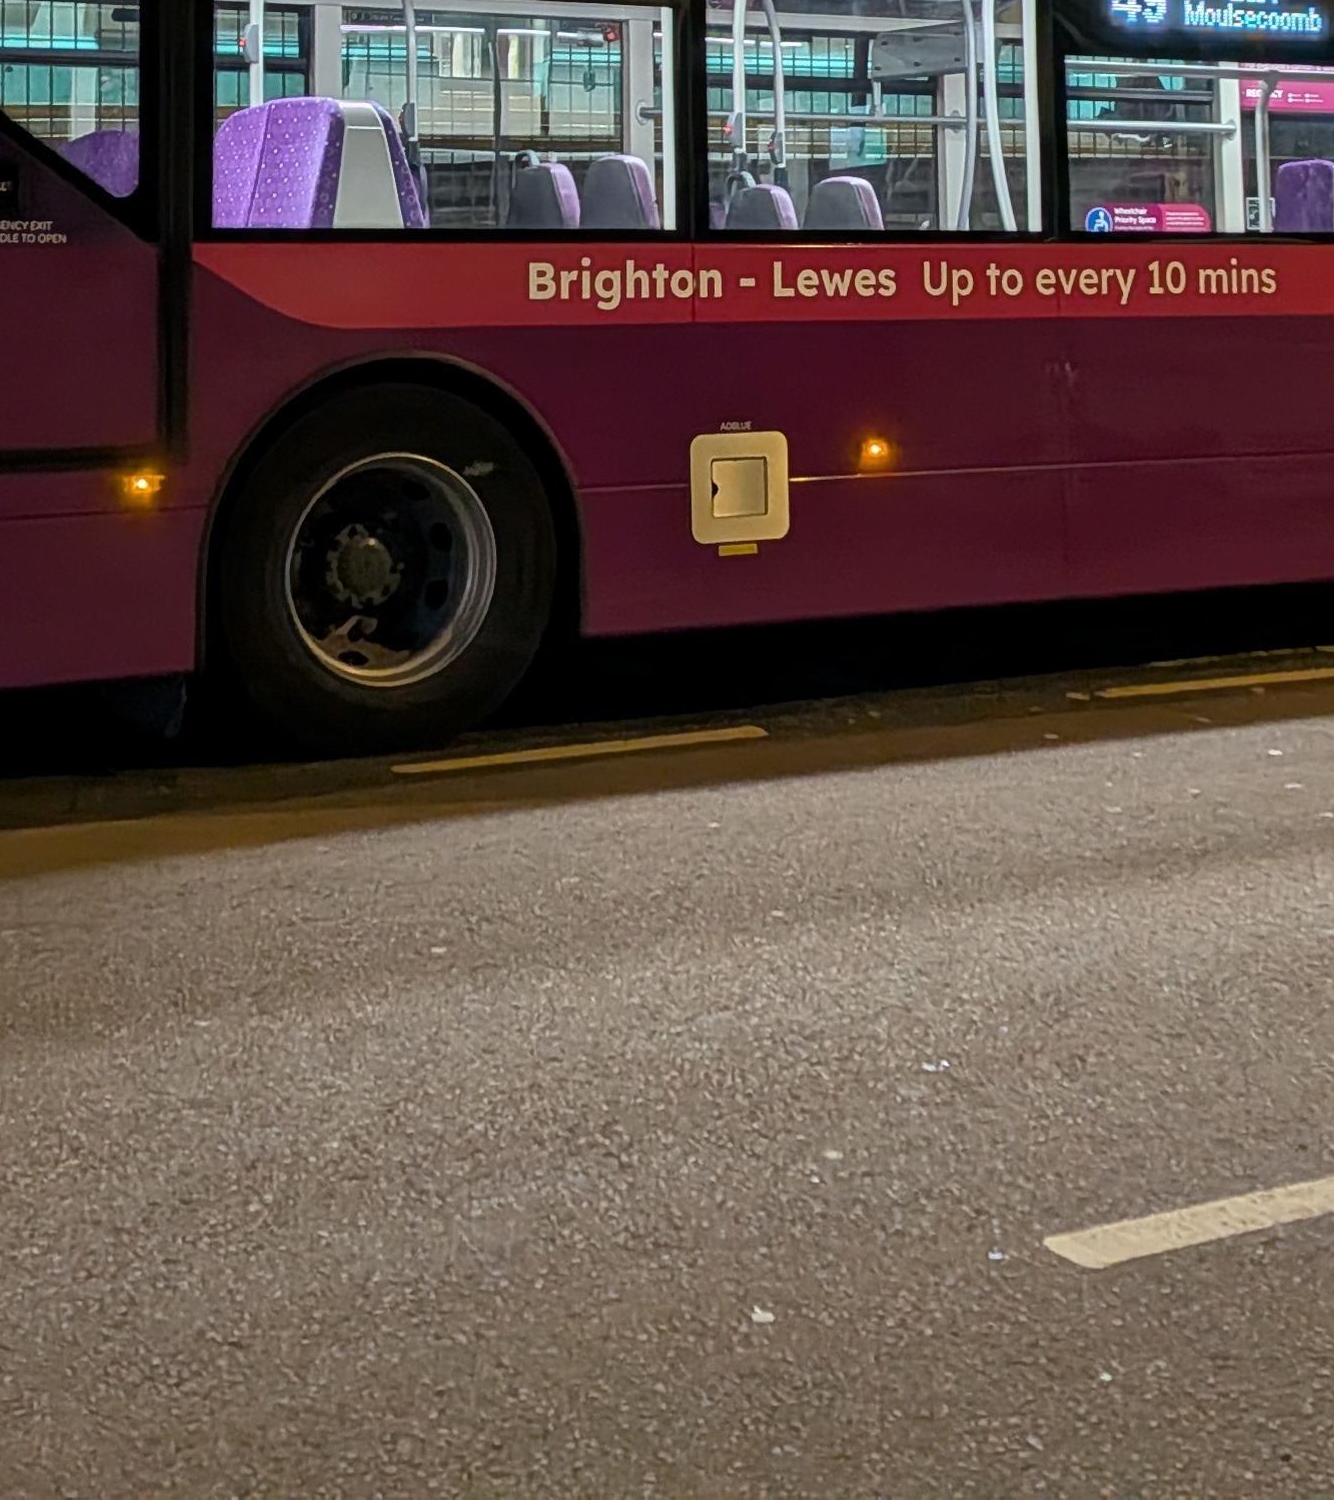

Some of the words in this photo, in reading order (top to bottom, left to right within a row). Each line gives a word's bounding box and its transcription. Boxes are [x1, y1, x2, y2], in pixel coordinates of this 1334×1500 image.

[1183, 0, 1323, 32] Moulsecoomb
[30, 220, 53, 231] EXIT
[21, 233, 36, 243] TO
[37, 233, 68, 244] OPEN
[528, 256, 723, 311] Brighton
[739, 277, 756, 288] -
[772, 260, 898, 298] Lewes
[922, 260, 974, 307] Up
[985, 262, 1024, 297] to
[1035, 266, 1137, 306] every
[1147, 260, 1186, 295] 10
[1197, 257, 1277, 295] mins
